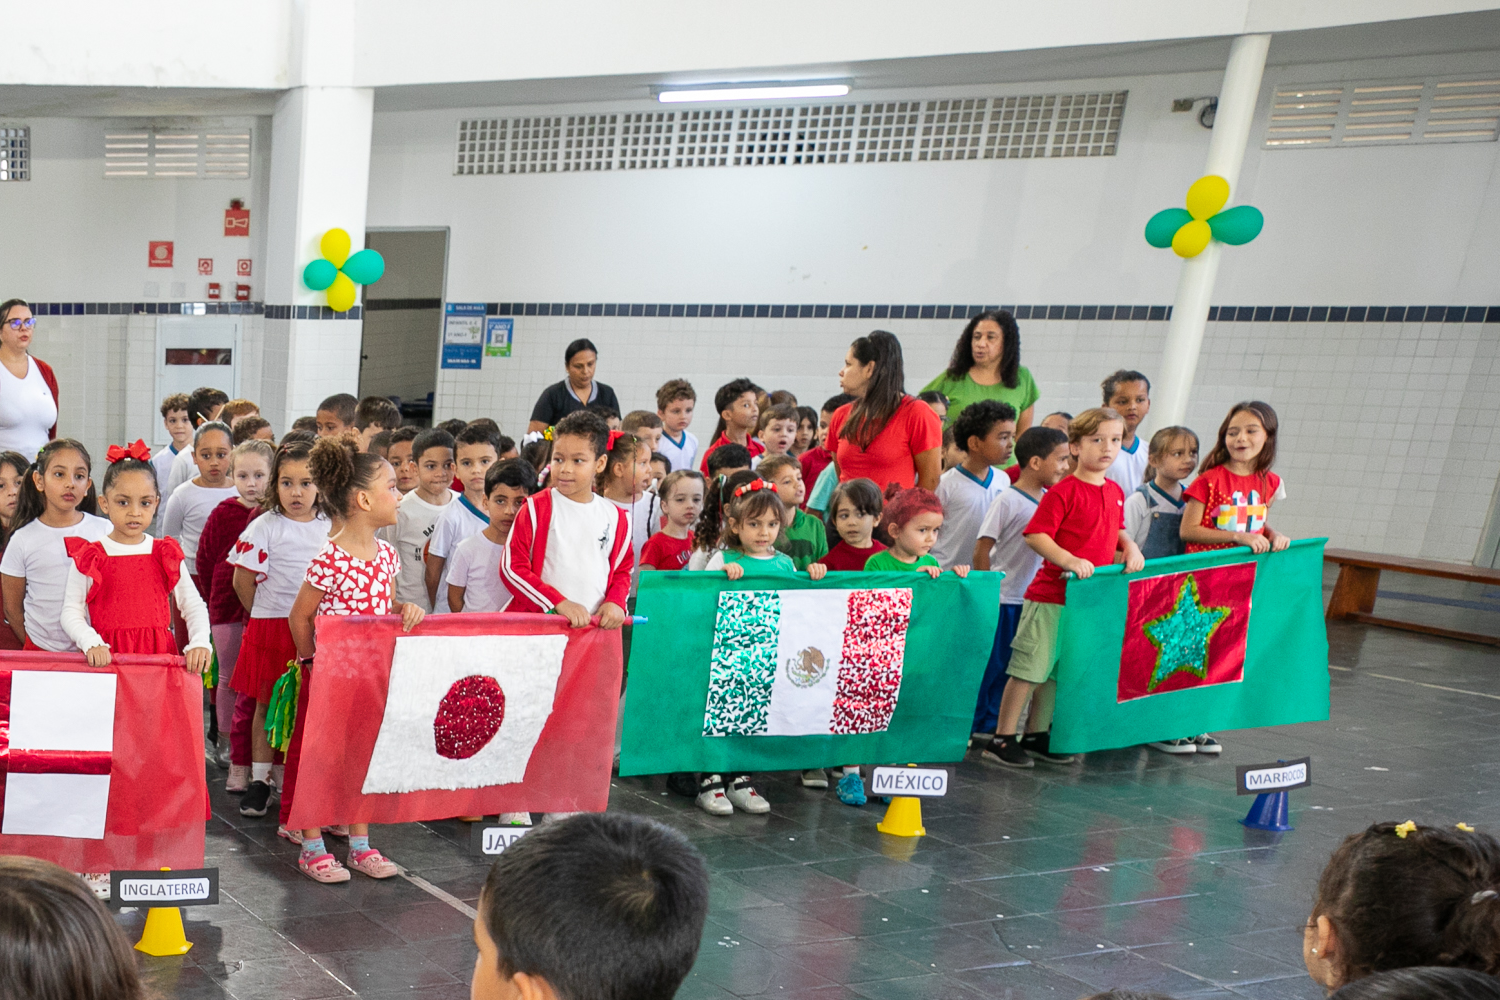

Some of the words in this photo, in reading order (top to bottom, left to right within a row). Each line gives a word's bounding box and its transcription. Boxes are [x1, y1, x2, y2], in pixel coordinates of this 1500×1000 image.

[875, 770, 944, 791] MÉXICO
[1249, 767, 1305, 785] MARROCOS
[485, 831, 530, 851] JAP
[124, 882, 205, 896] INGLATERRA
